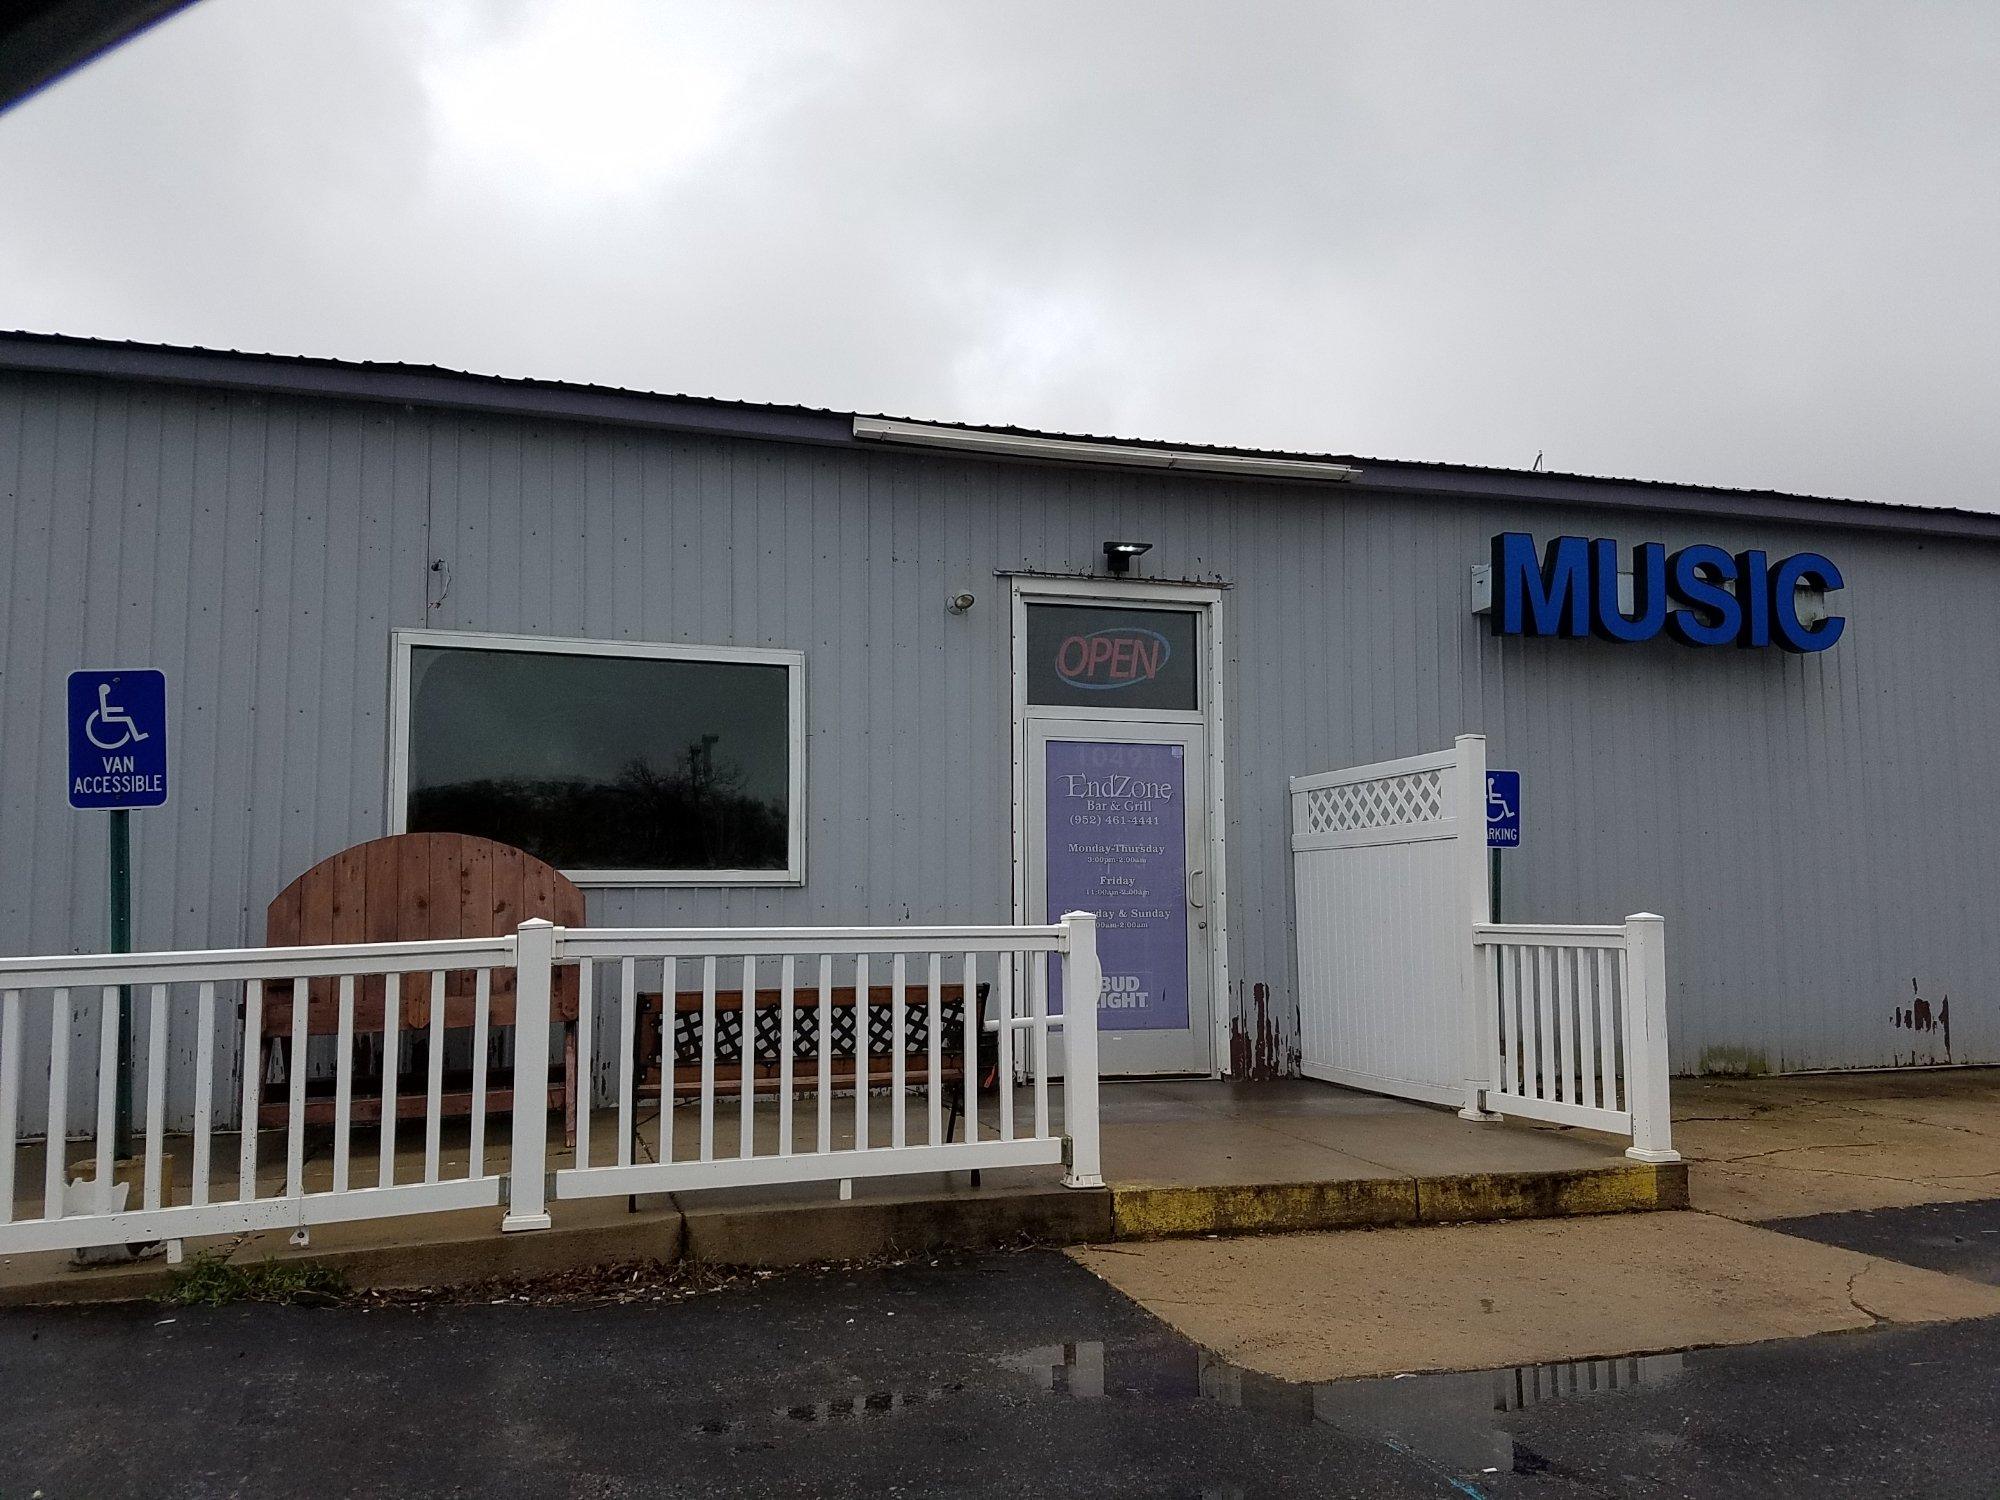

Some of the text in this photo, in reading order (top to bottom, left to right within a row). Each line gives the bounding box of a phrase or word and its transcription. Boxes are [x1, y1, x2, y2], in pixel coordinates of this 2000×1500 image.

[1491, 532, 1845, 653] MUSIC
[1058, 636, 1160, 680] OPEN
[102, 756, 134, 774] VAN
[73, 774, 163, 794] ACCESSIBLE
[1056, 772, 1174, 804] EndZone
[1087, 800, 1152, 812] Bar & Grill
[1069, 815, 1160, 826] (952) 461-4441
[1068, 843, 1166, 855] Monday-Thursday
[1100, 876, 1136, 887] Friday
[1118, 909, 1128, 918] &
[1130, 908, 1171, 920] Sunday
[1101, 976, 1140, 992] BUD
